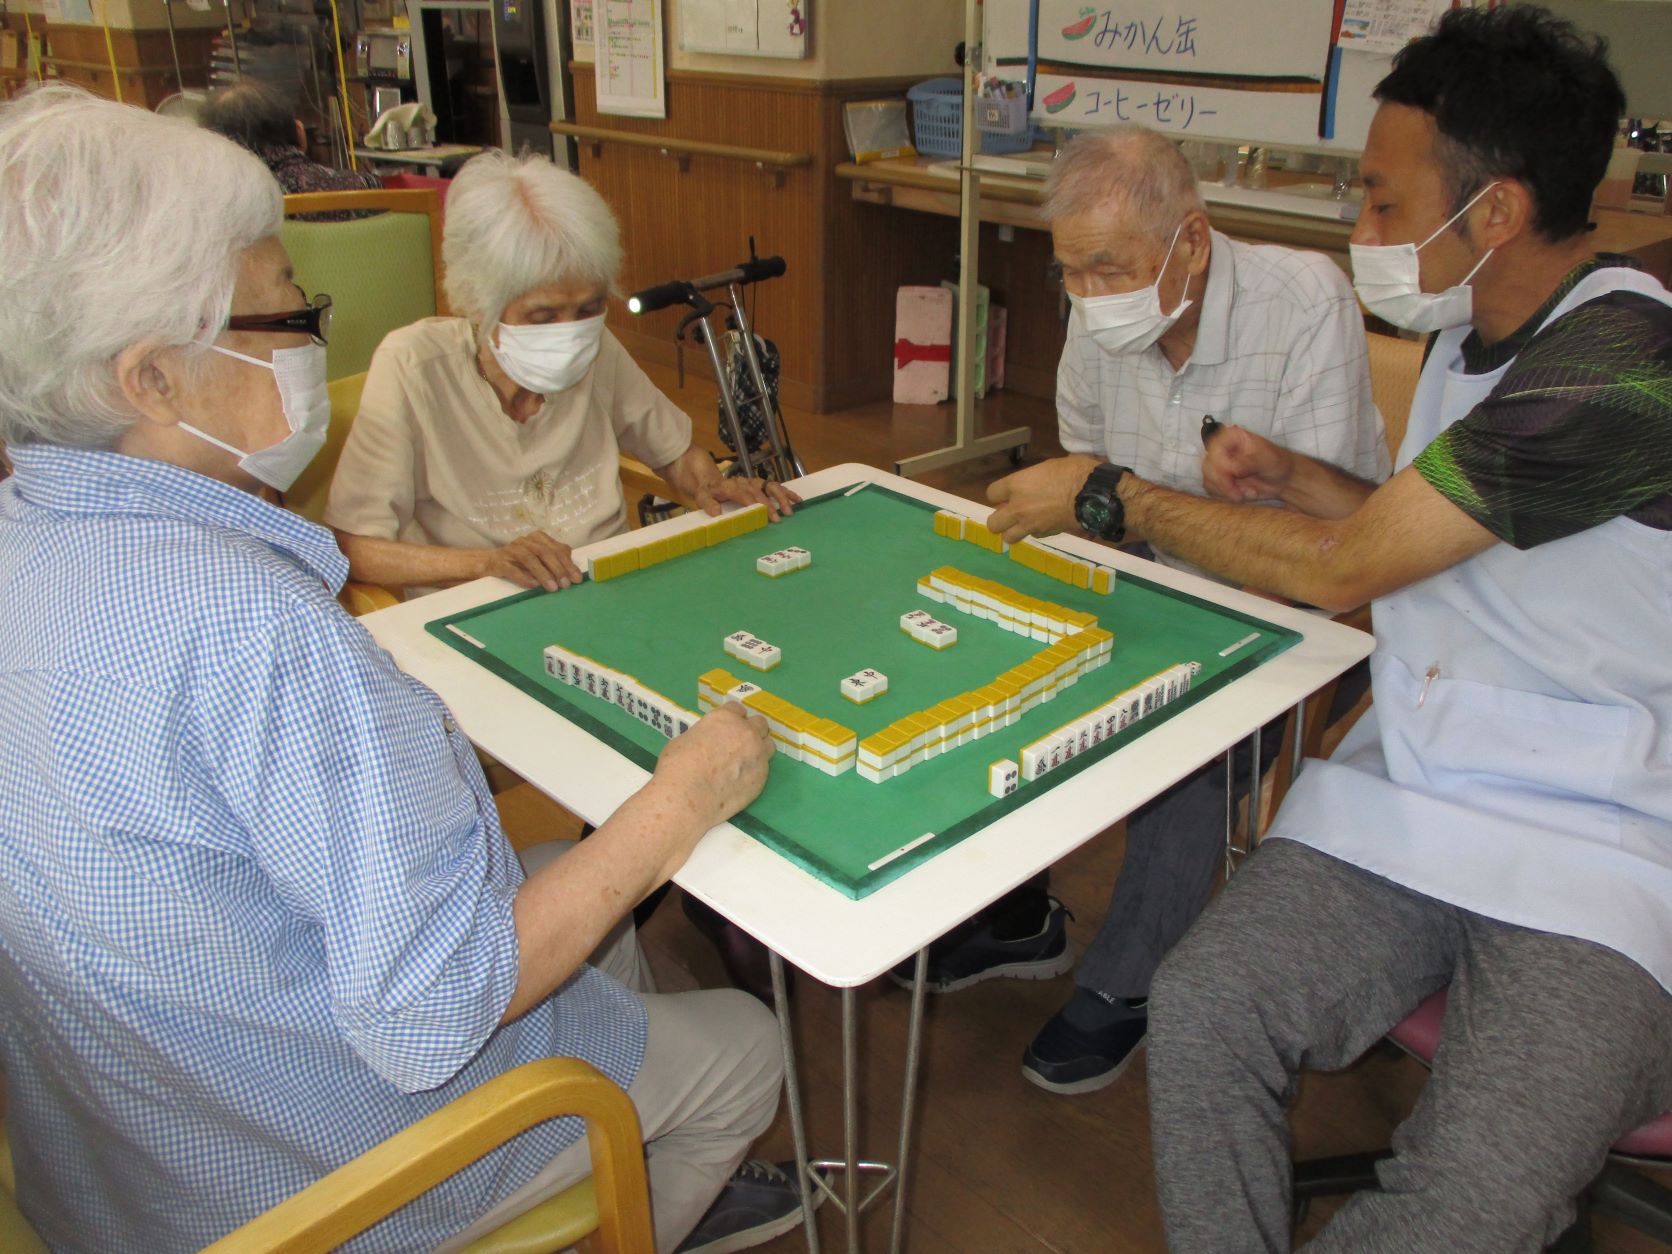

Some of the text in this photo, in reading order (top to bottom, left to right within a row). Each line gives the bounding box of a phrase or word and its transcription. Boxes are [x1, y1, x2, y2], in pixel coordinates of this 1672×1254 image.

[1094, 10, 1198, 57] みかん缶
[1084, 87, 1217, 129] コーヒーゼリー
